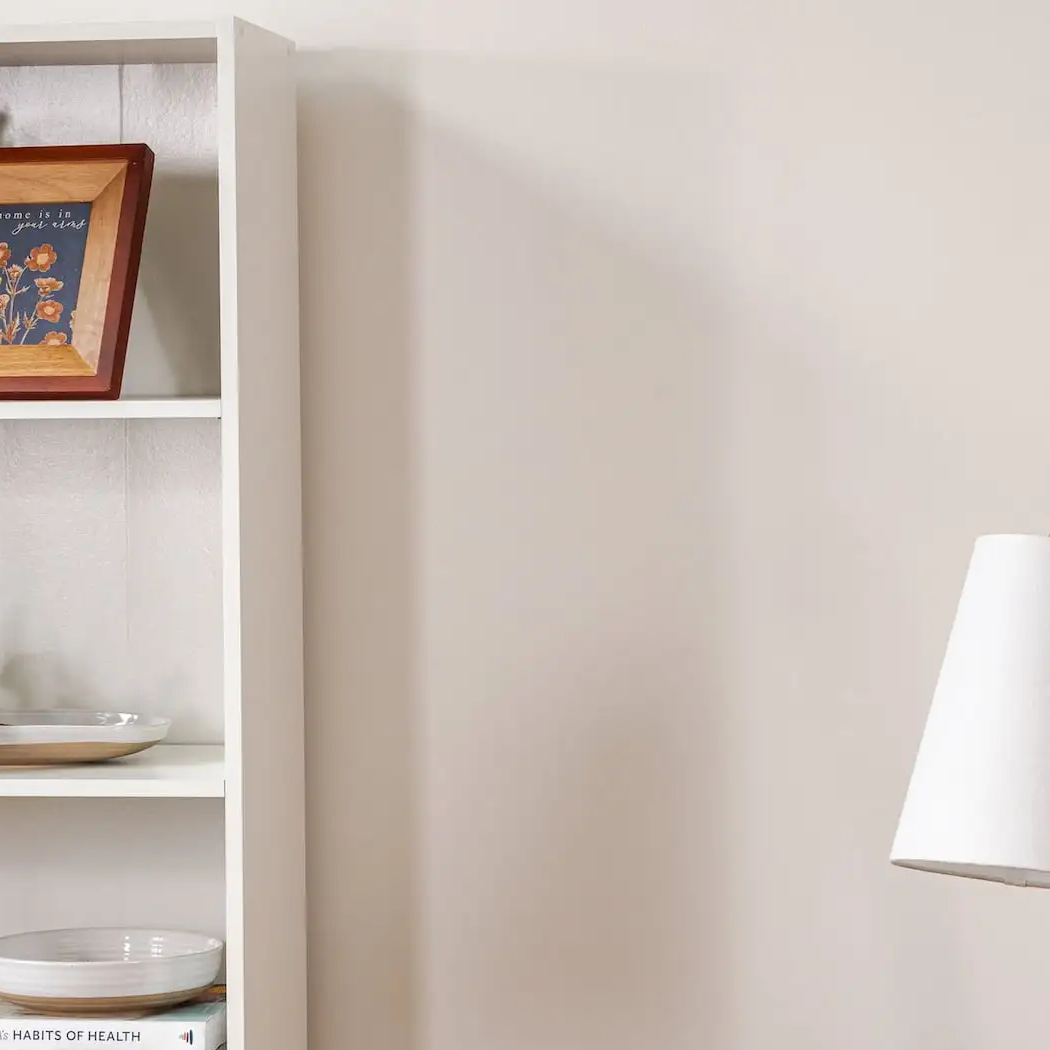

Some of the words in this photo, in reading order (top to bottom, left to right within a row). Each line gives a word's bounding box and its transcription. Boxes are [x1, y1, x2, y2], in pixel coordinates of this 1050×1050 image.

[38, 209, 51, 219] is
[58, 208, 71, 219] in
[11, 220, 48, 236] your
[52, 218, 87, 230] arms
[12, 1029, 62, 1042] HABITS
[66, 1030, 85, 1042] OF
[87, 1030, 142, 1043] HEALTH
